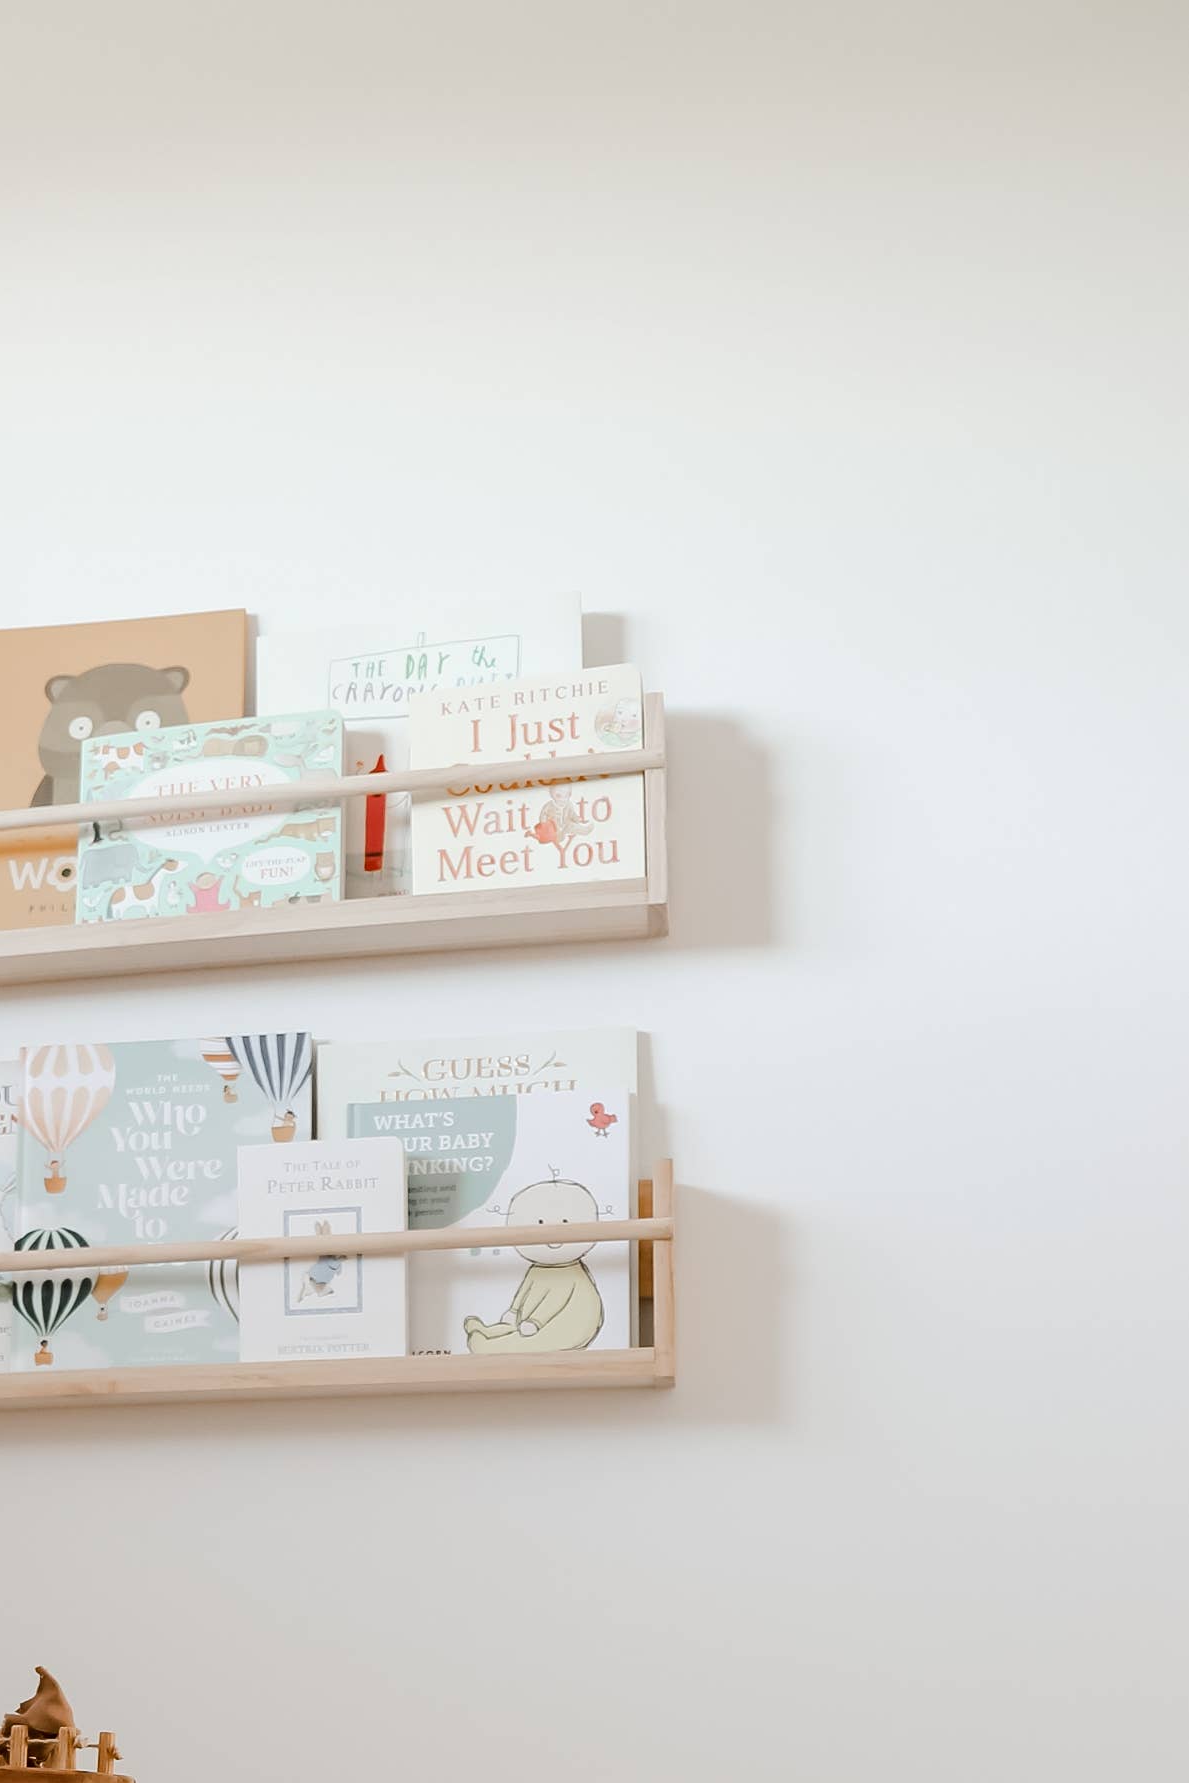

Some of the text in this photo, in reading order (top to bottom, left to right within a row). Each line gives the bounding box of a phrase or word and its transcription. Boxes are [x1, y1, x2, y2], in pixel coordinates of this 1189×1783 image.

[351, 659, 387, 679] THE
[405, 651, 451, 680] DAY
[471, 645, 498, 668] the
[332, 681, 438, 704] CRAYON
[440, 680, 610, 717] KATE RITCHIE
[470, 711, 580, 752] I Just
[155, 774, 267, 798] THE VERY
[209, 822, 250, 832] LESTER
[443, 795, 612, 838] Wait to
[437, 834, 620, 882] Meet You
[260, 866, 293, 879] FUN!
[422, 1054, 531, 1082] GUESS
[128, 1100, 206, 1136] Who
[374, 1111, 455, 1131] WHAT'S
[110, 1127, 172, 1153] You
[403, 1132, 495, 1152] UR BABY
[134, 1156, 223, 1181] Were
[408, 1156, 494, 1176] NKING?
[97, 1182, 189, 1219] Made
[133, 1216, 167, 1239] to
